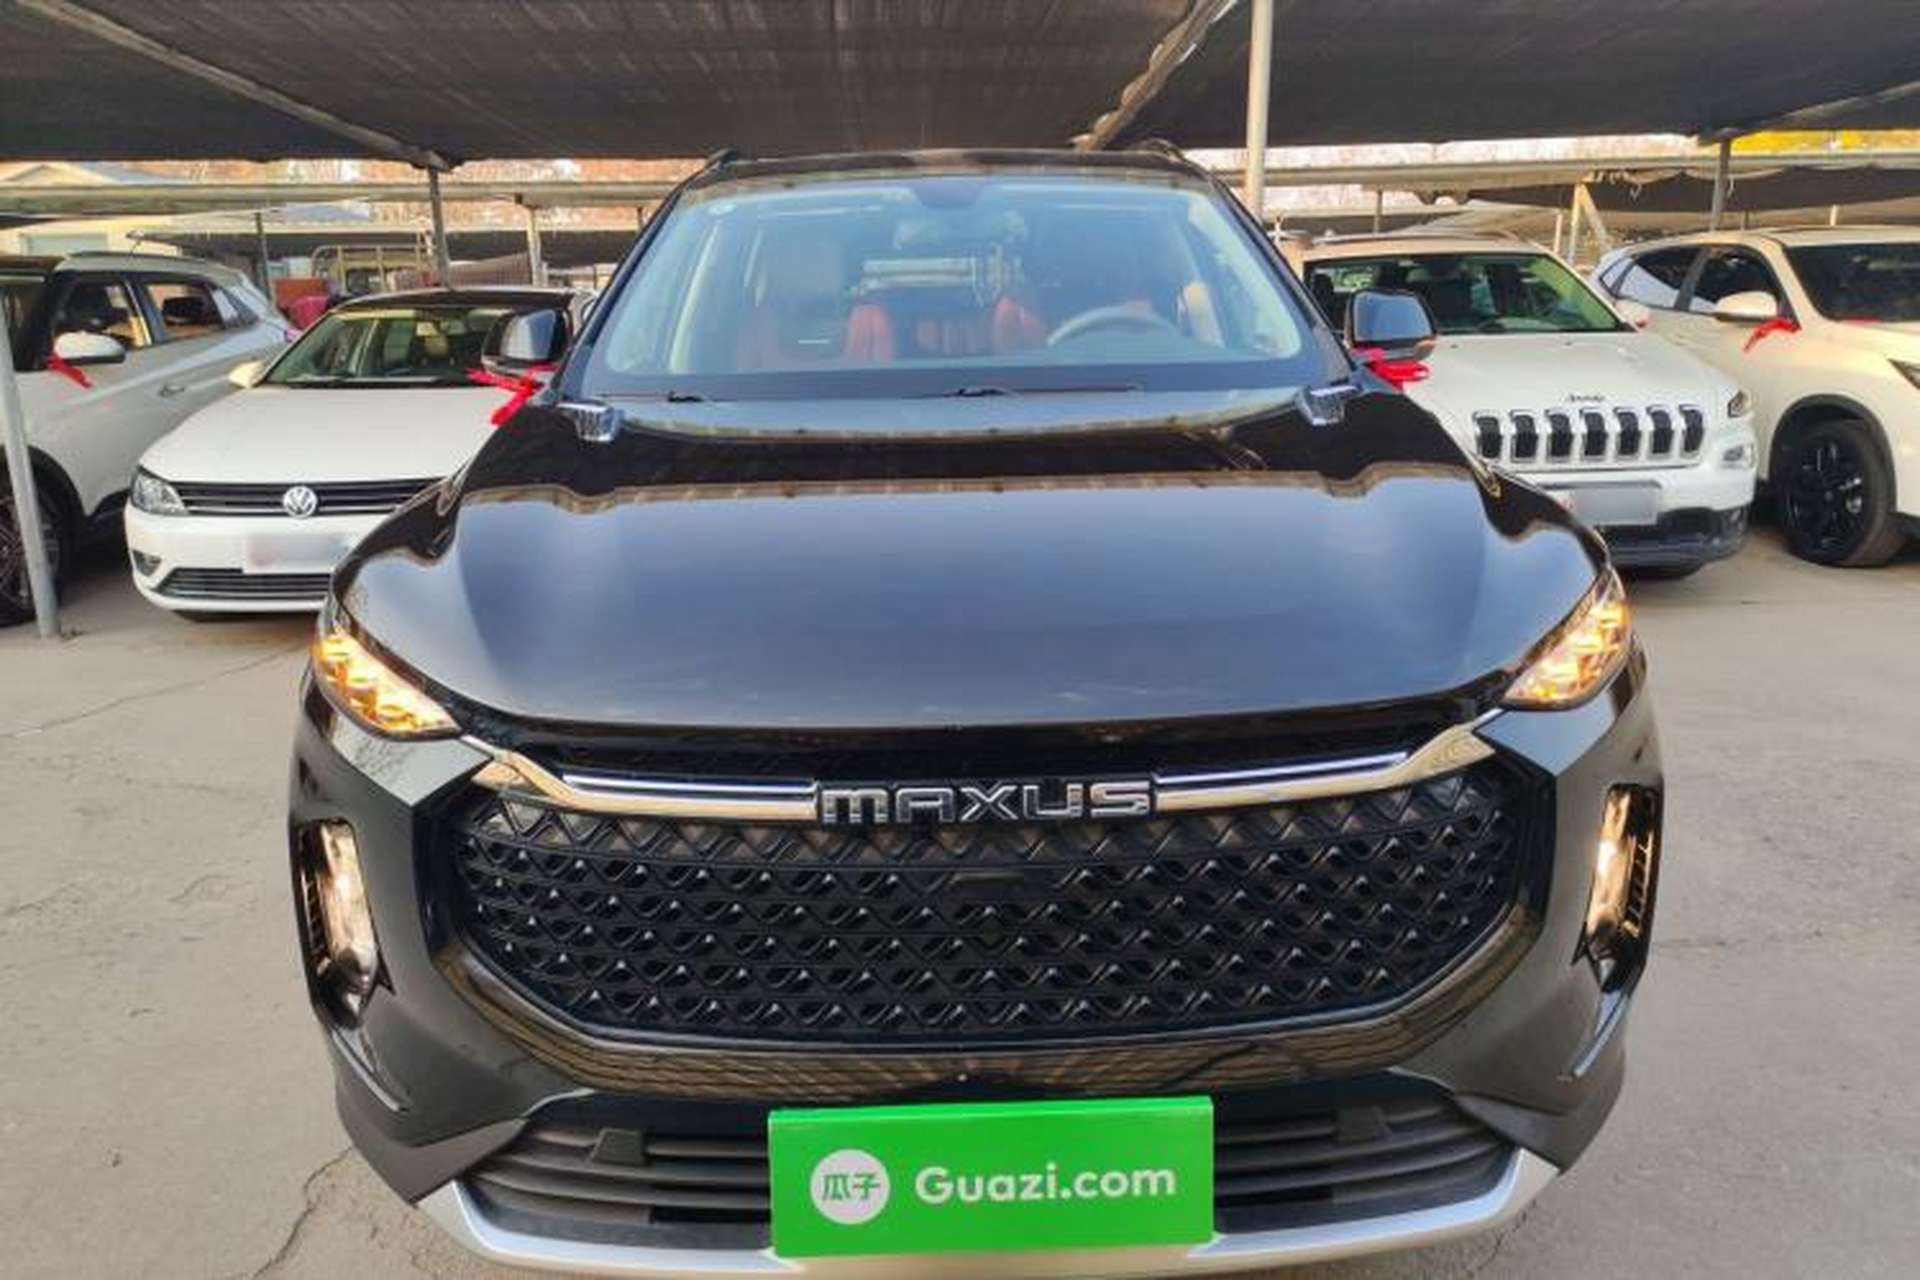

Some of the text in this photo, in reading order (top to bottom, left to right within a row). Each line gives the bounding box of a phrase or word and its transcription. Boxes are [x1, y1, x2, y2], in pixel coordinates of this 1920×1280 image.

[820, 780, 1151, 824] MAXUS
[821, 1162, 1177, 1204] 瓜子 Guazi.com
